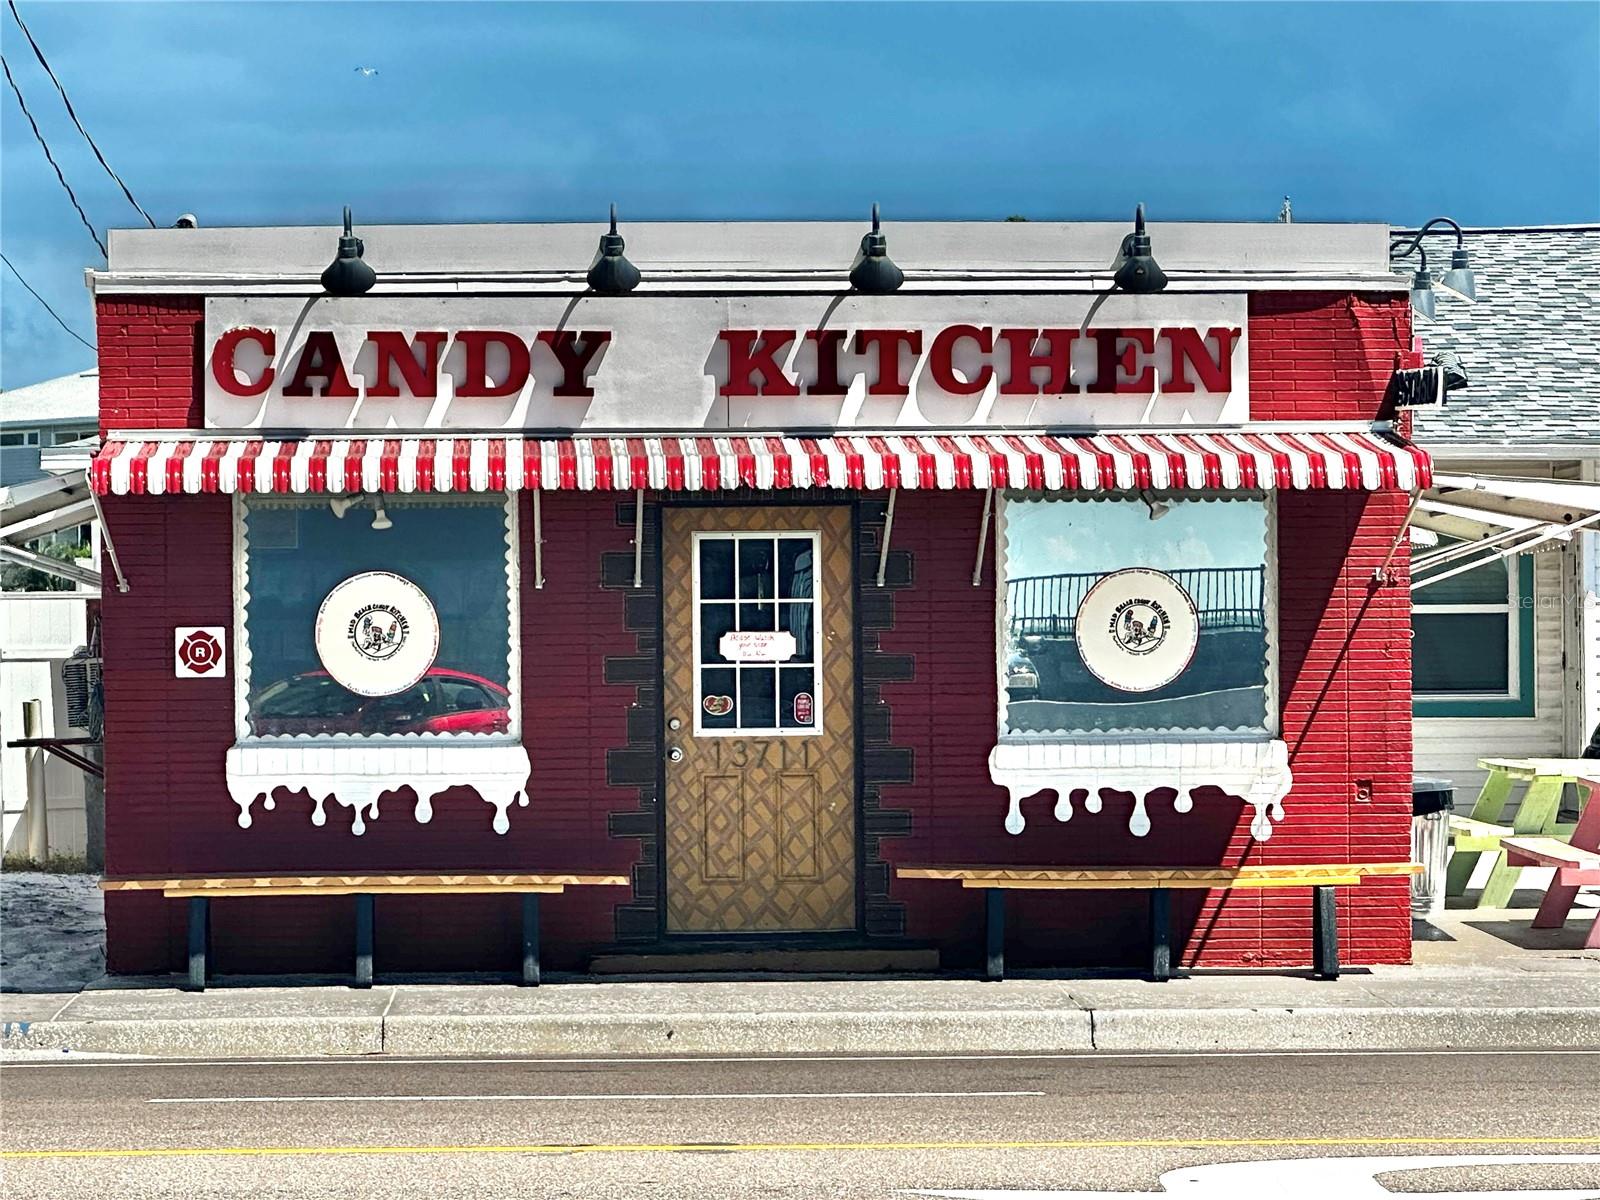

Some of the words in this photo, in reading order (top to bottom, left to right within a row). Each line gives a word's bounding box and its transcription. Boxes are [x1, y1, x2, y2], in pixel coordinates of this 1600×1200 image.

[211, 325, 612, 397] CANDY
[719, 324, 1242, 397] KITCHEN
[195, 647, 206, 658] R
[712, 739, 809, 769] 13711
